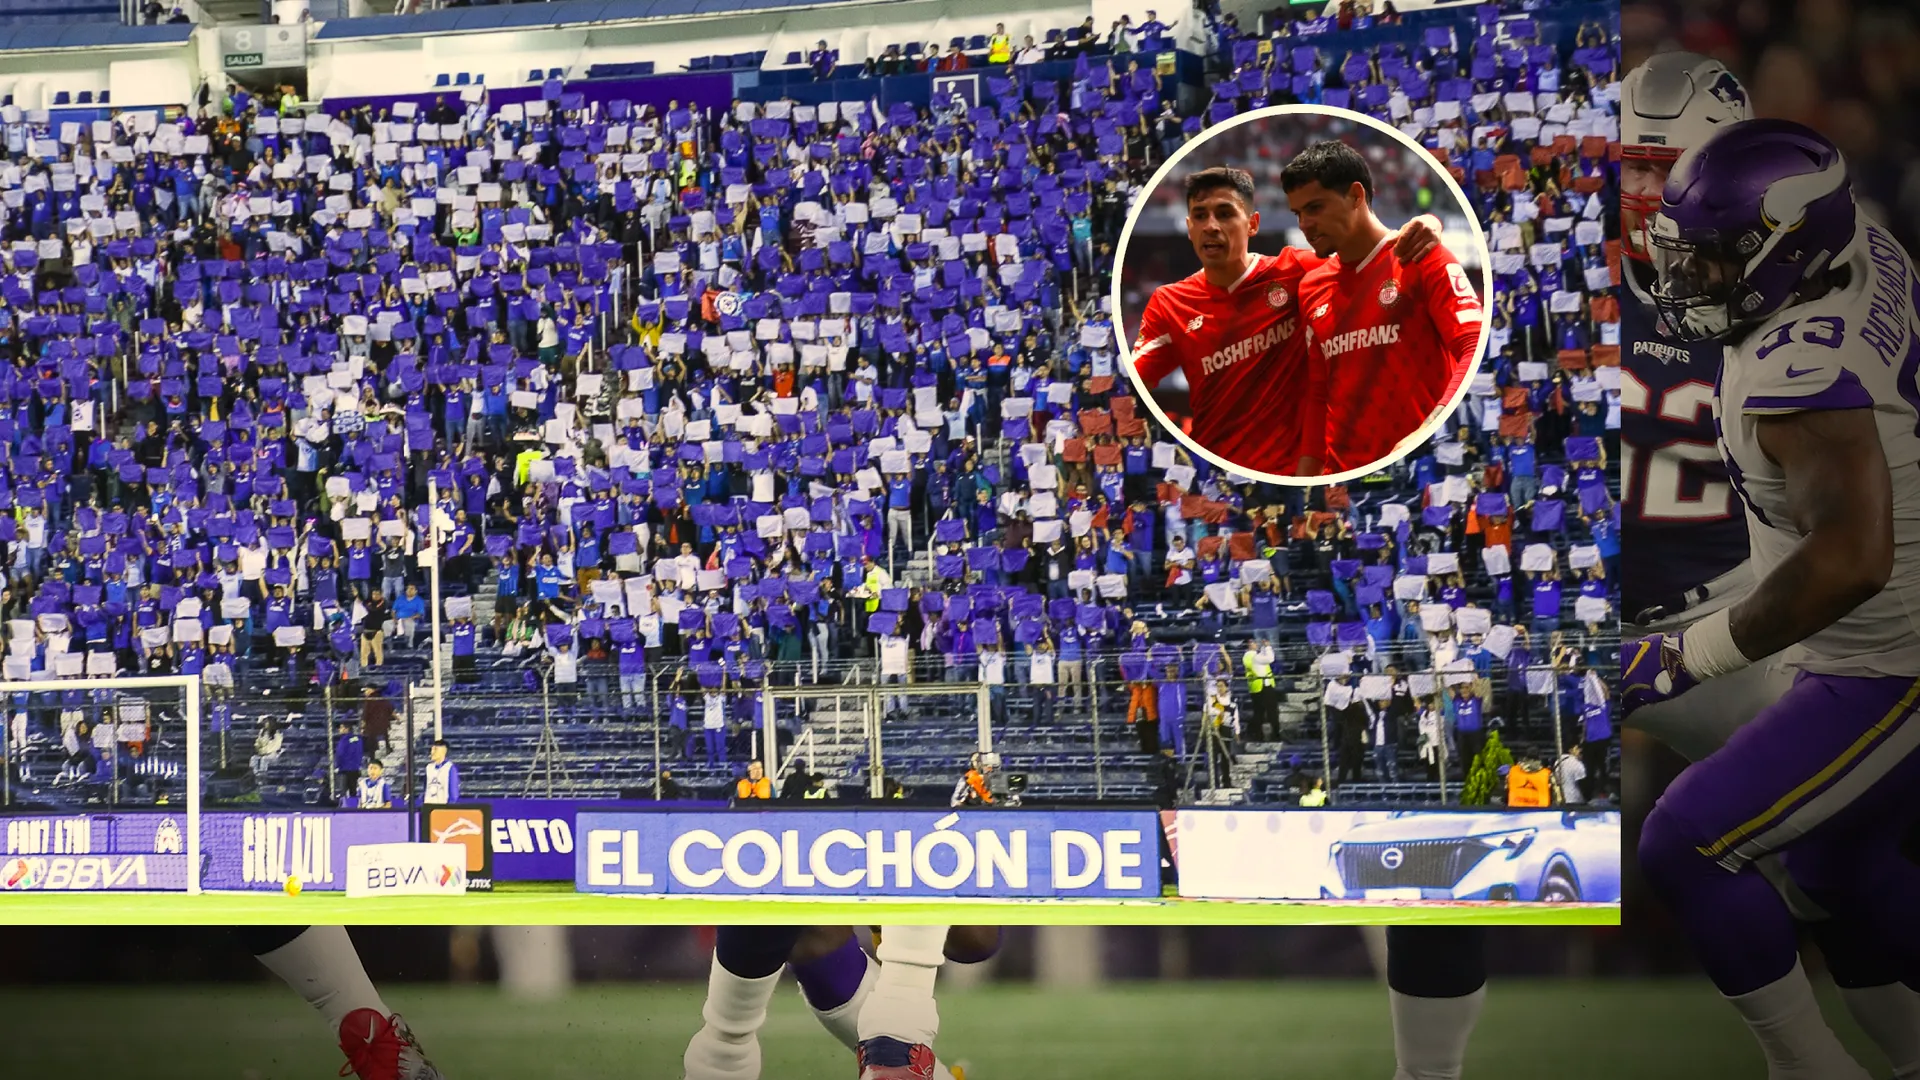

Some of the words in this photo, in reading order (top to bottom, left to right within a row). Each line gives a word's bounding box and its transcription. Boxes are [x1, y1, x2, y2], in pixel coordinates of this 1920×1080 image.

[235, 30, 252, 51] 8
[226, 54, 261, 66] SALIDA
[1201, 317, 1296, 376] ROSHFRANS
[1633, 341, 1690, 363] PATRIOTS
[242, 816, 288, 884] CRUZ
[291, 816, 334, 885] AZUL
[491, 818, 574, 854] ENTO
[587, 829, 654, 887] EL
[668, 811, 1028, 890] COLCHÓN
[1050, 830, 1143, 890] DE
[43, 855, 148, 890] BBVA
[367, 865, 429, 889] BBVA
